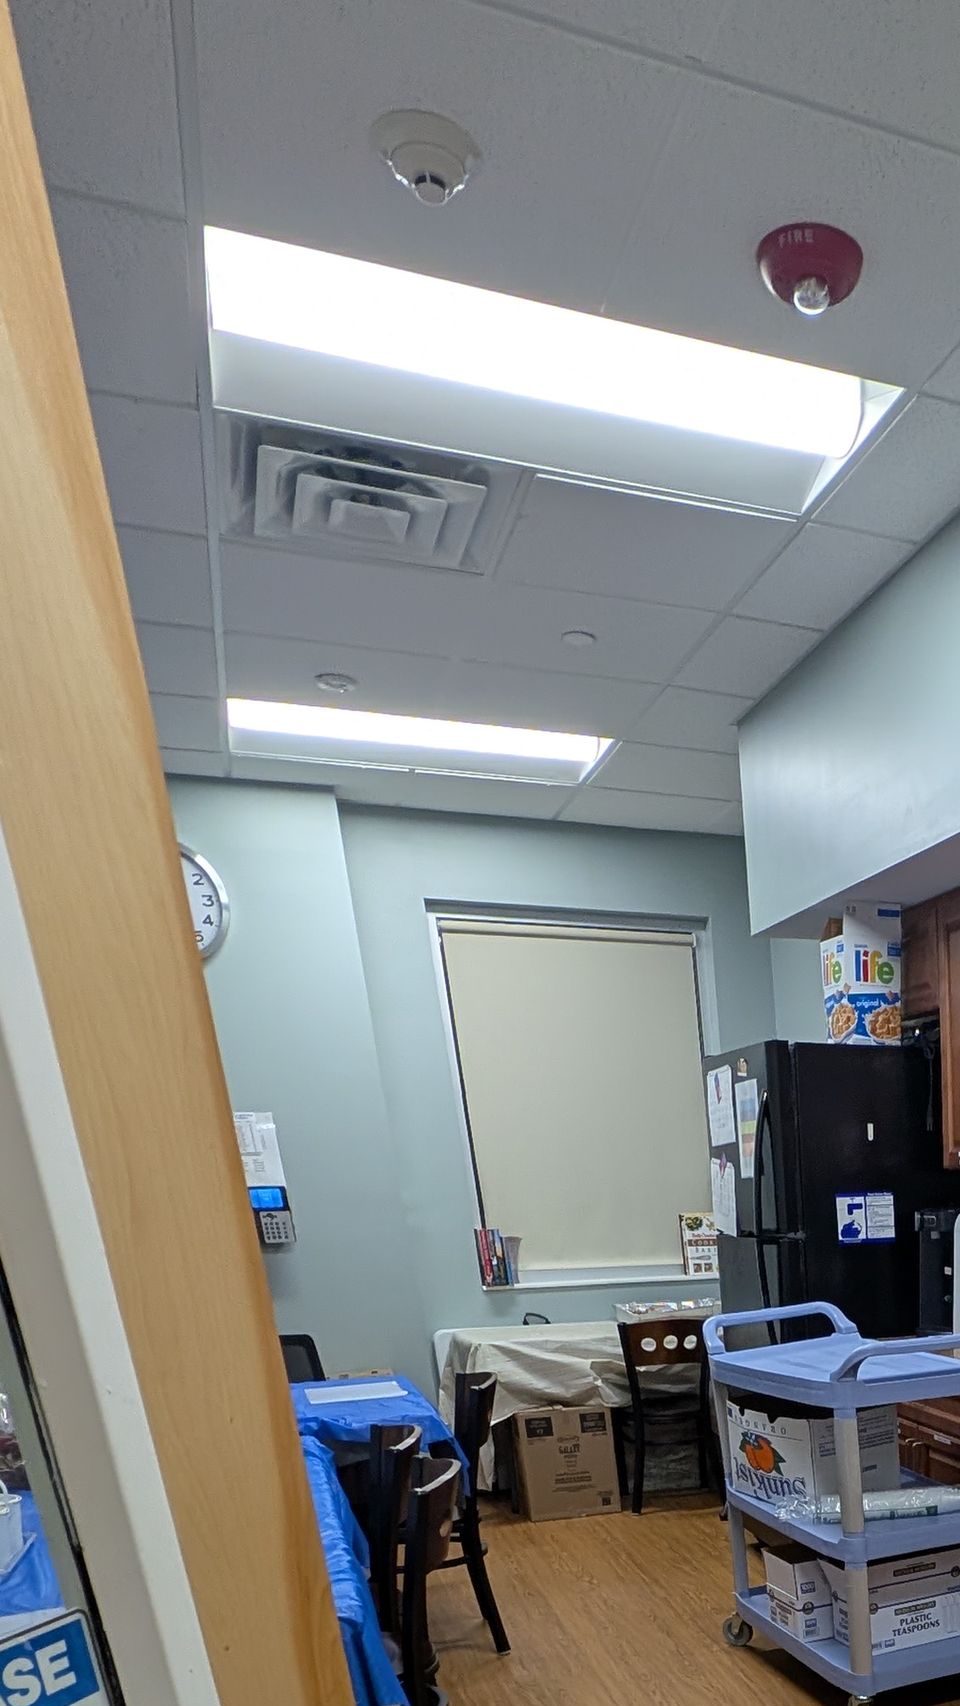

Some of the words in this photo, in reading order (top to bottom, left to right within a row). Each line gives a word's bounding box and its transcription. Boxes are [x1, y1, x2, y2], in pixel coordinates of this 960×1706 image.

[778, 229, 814, 248] FIRE
[192, 873, 204, 886] 2
[201, 894, 215, 907] 3
[202, 914, 214, 927] 4
[855, 950, 894, 985] life
[733, 1456, 807, 1500] Sunkist
[900, 1612, 932, 1626] PLASTIC
[892, 1619, 940, 1637] TEASPOONS
